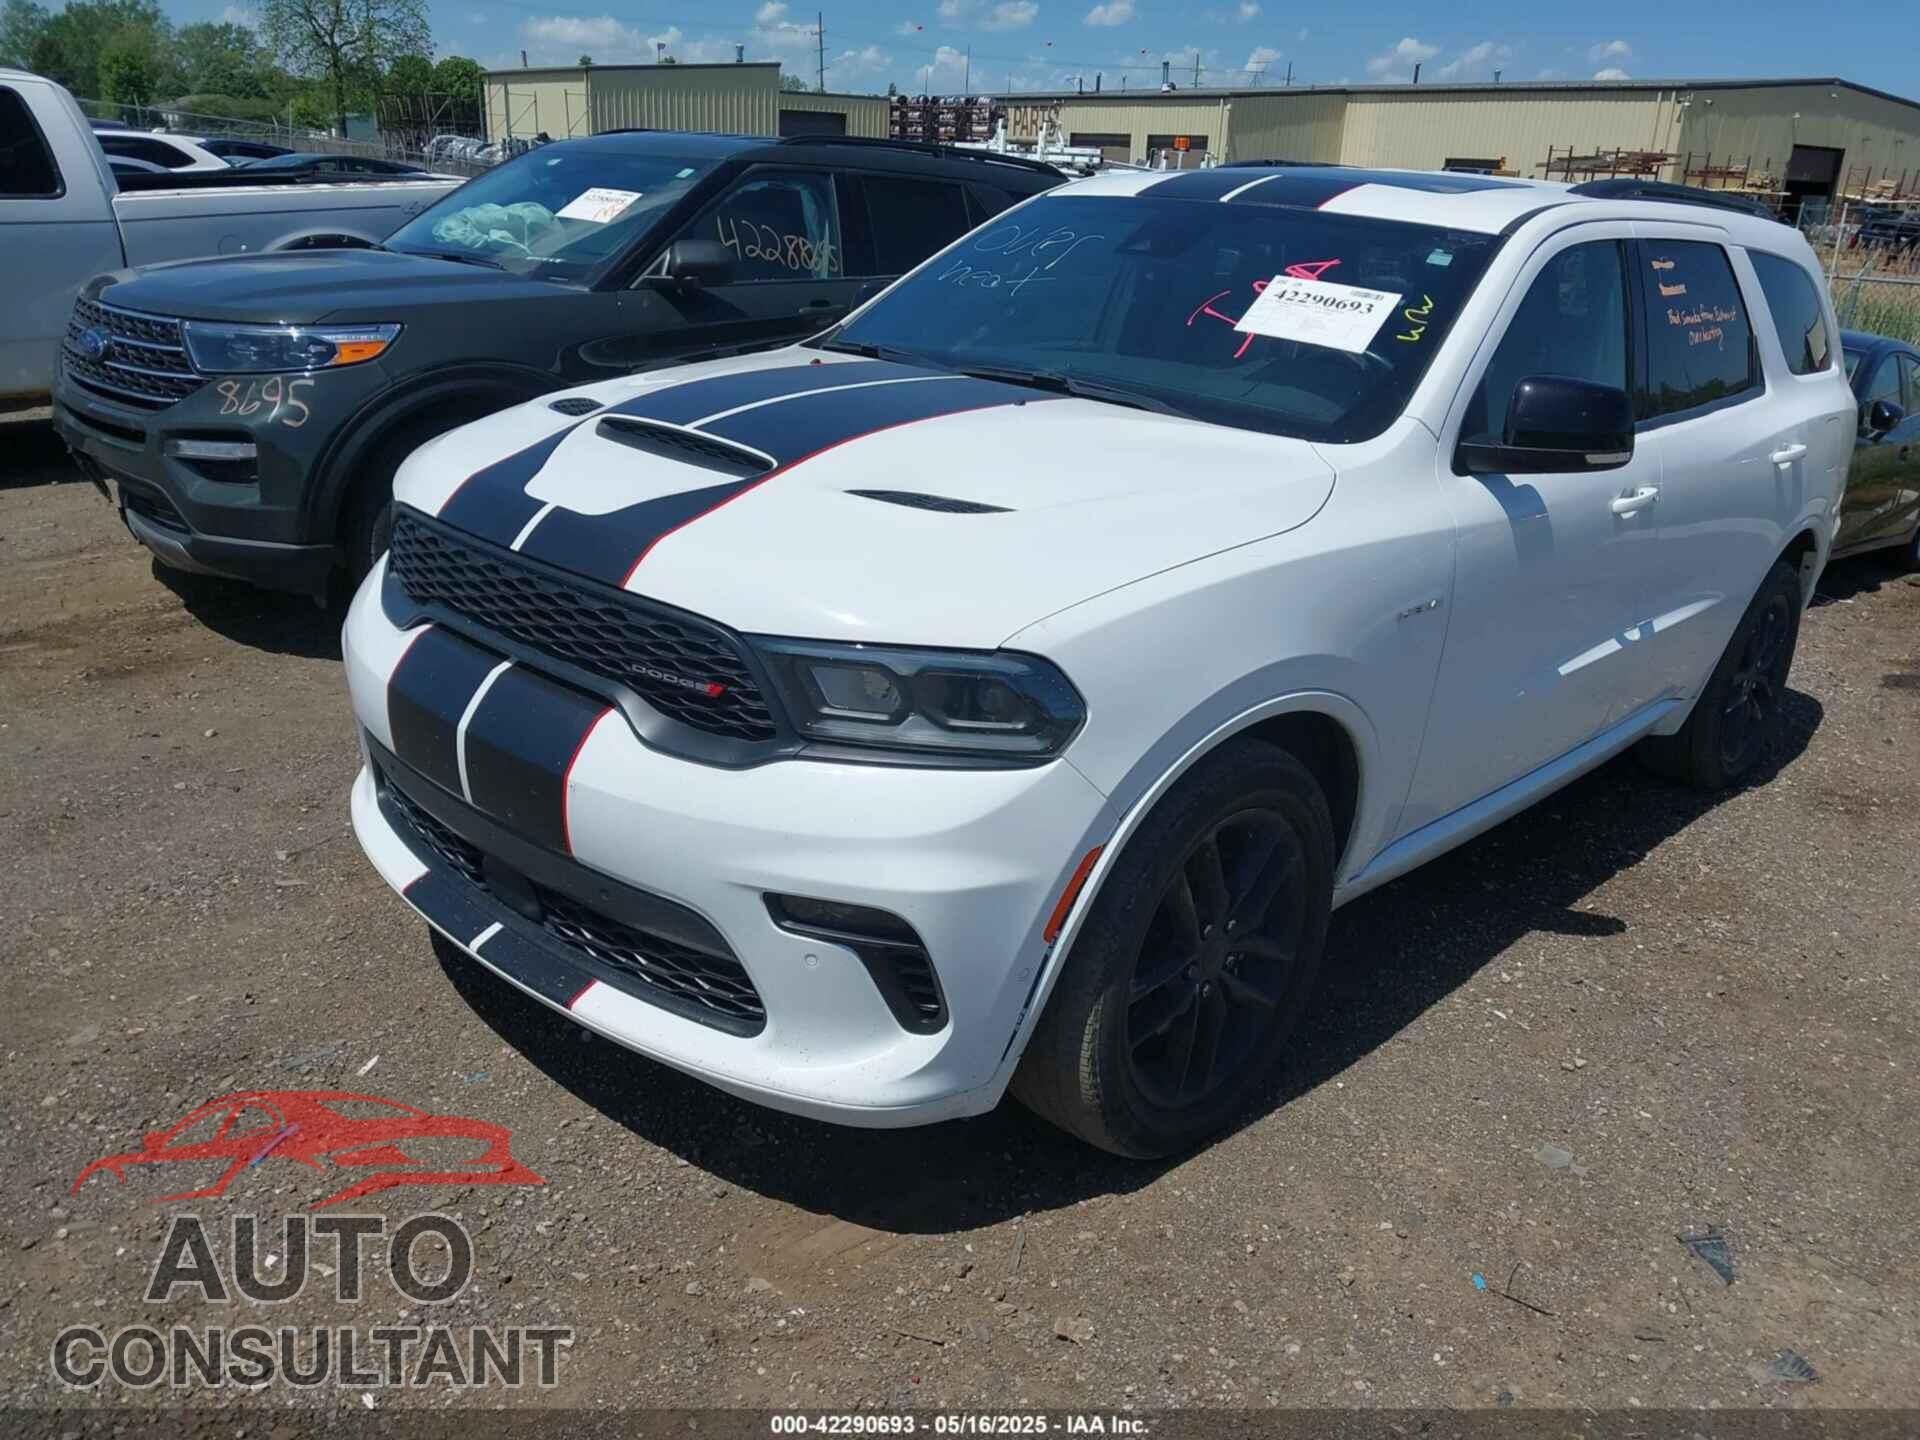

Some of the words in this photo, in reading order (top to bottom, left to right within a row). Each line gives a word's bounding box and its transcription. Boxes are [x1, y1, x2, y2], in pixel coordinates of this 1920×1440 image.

[1274, 289, 1375, 314] 42290693
[217, 376, 315, 427] 8695
[631, 663, 705, 692] DODGE
